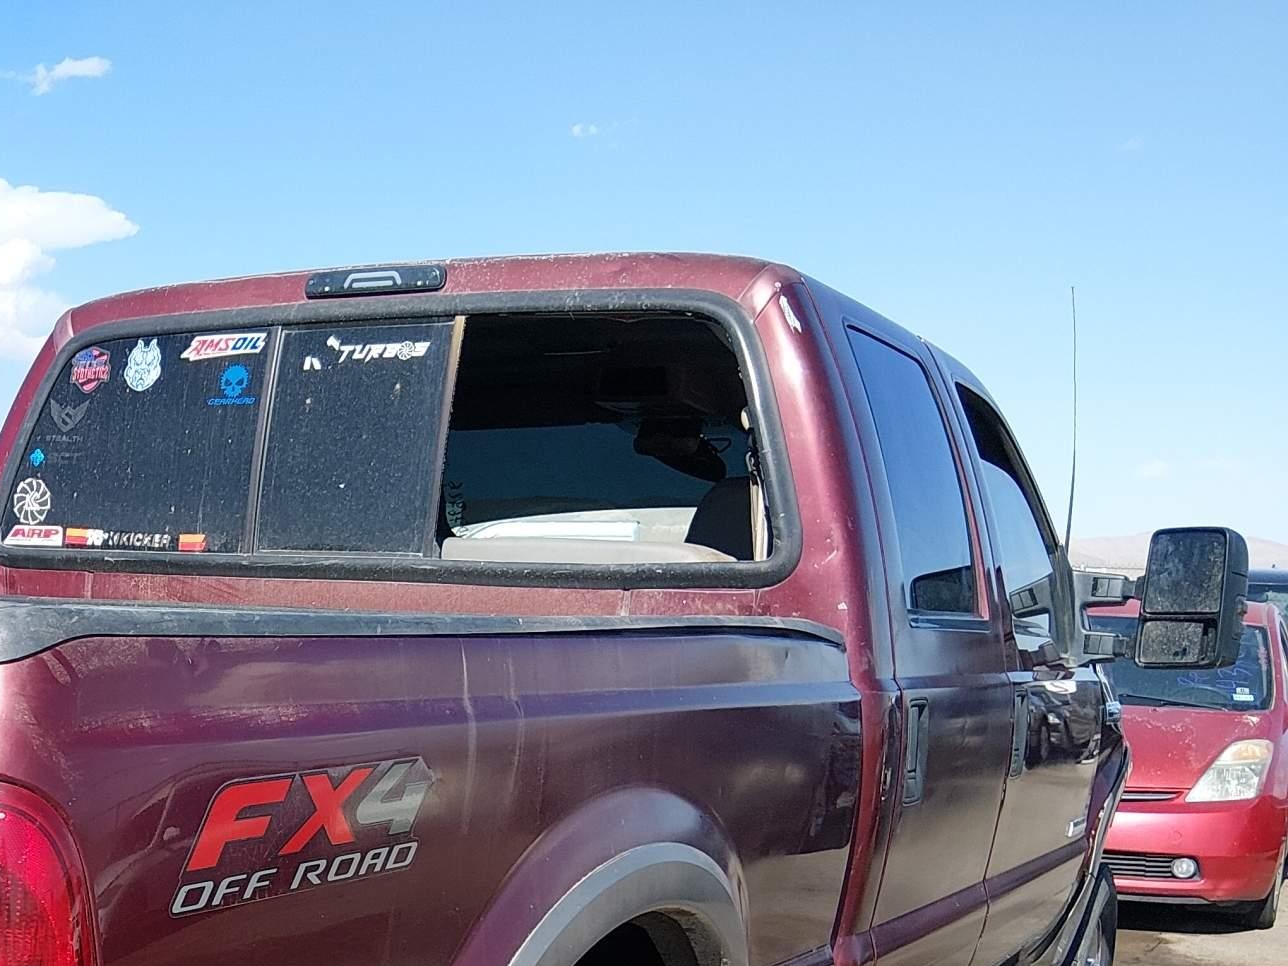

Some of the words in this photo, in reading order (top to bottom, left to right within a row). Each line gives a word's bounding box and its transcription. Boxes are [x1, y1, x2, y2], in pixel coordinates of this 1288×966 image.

[189, 336, 262, 356] AMSOIL
[207, 397, 256, 406] GEARHEAD
[10, 528, 60, 538] ARP
[186, 758, 431, 872] FX4
[171, 868, 278, 914] OFF
[290, 841, 418, 889] ROAD
